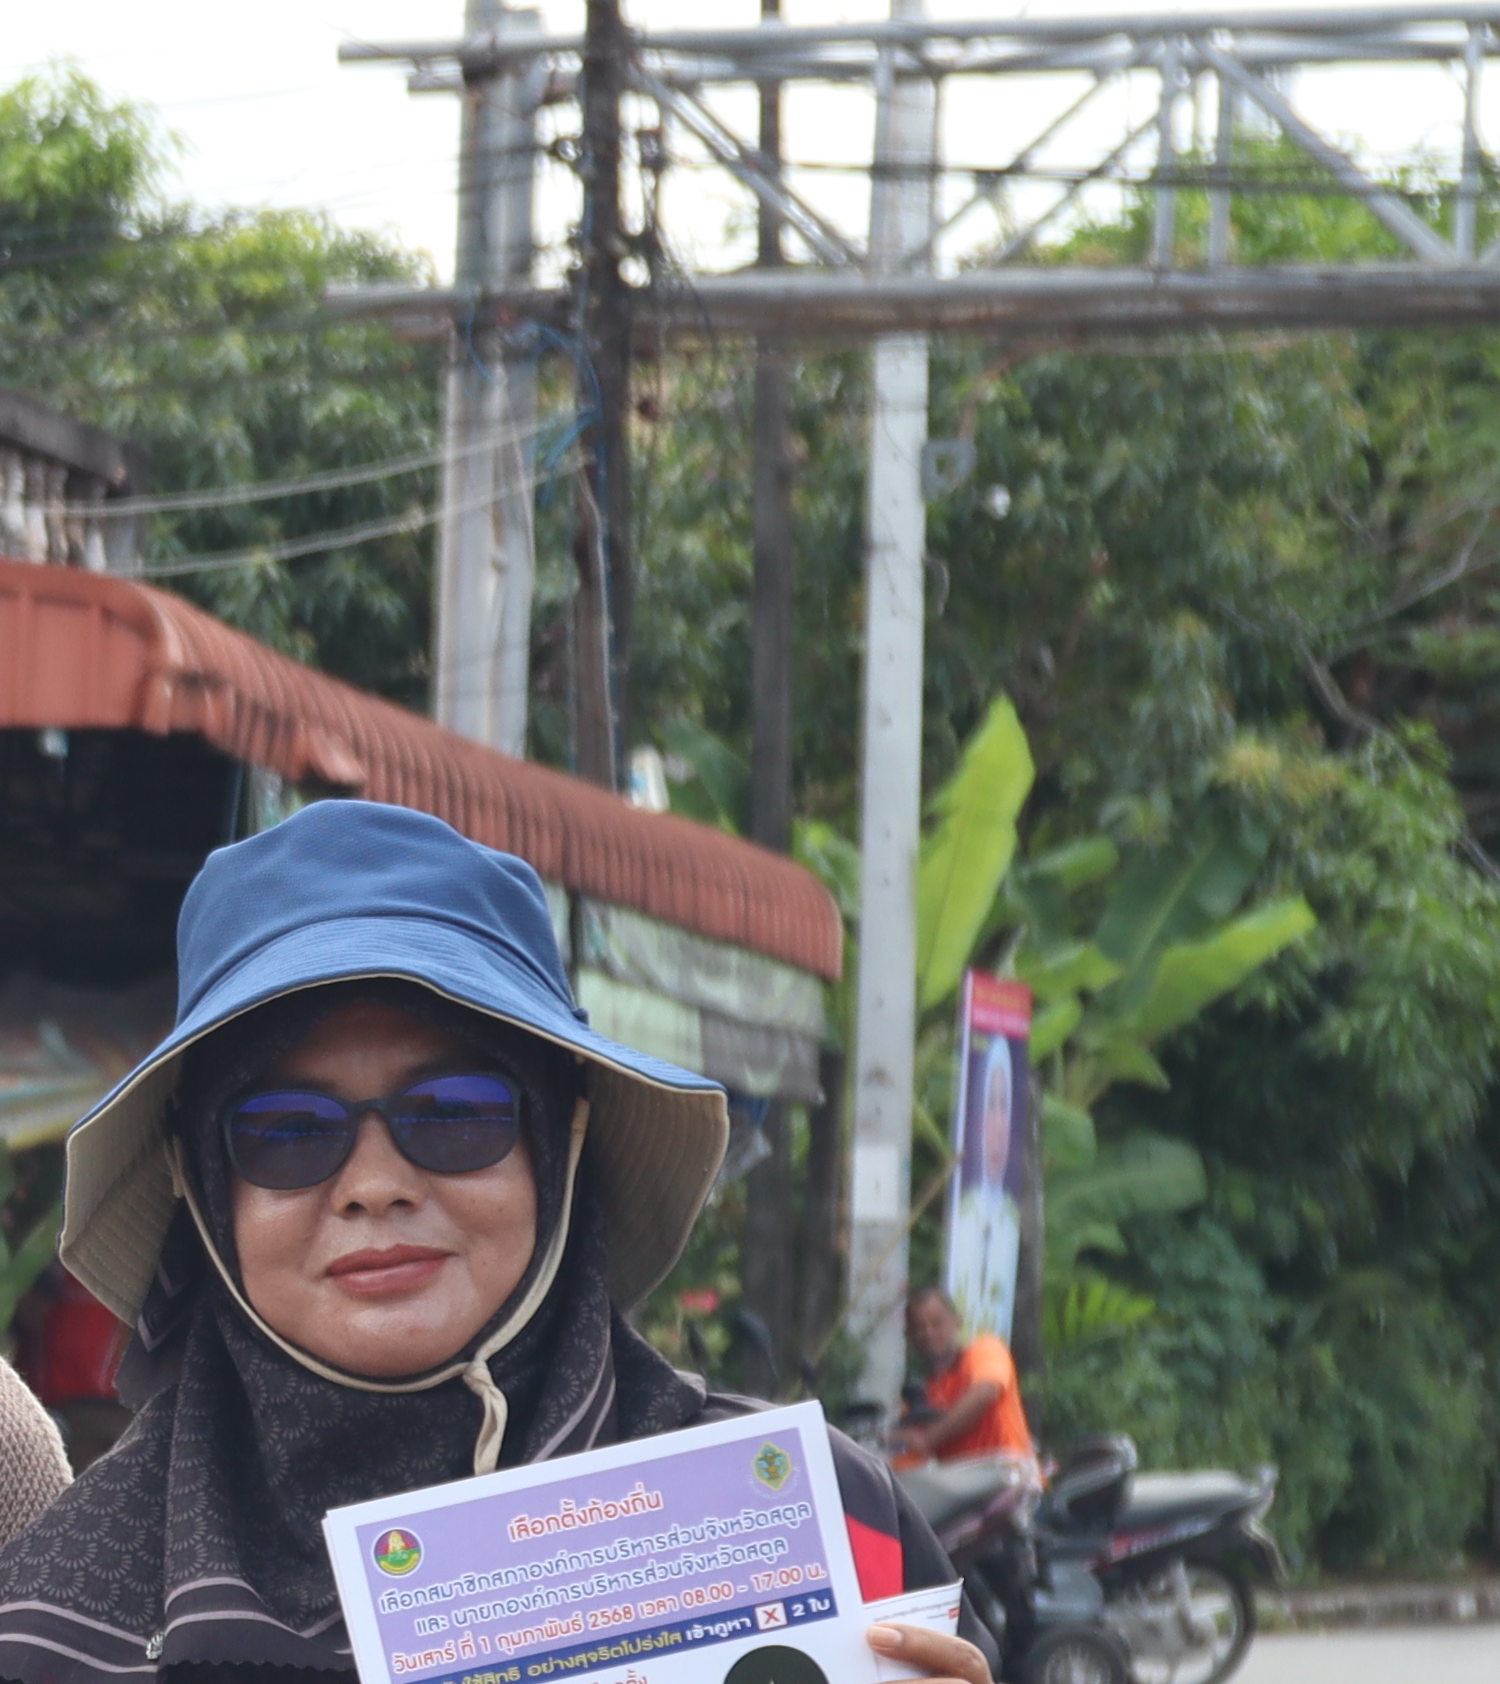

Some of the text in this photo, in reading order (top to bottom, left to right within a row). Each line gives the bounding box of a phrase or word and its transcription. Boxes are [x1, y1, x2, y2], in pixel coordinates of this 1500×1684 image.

[504, 1482, 662, 1543] เลือกตั้งท้องถิ่น
[391, 1639, 457, 1672] วันเสาร์
[457, 1633, 475, 1659] ที่
[477, 1636, 490, 1654] 1
[494, 1610, 584, 1655] กุมภาพันธ์
[586, 1603, 634, 1630] 2568
[637, 1594, 678, 1618] เวลา
[680, 1579, 733, 1607] 08.00
[749, 1563, 802, 1591] 17.00
[803, 1561, 825, 1579] น.
